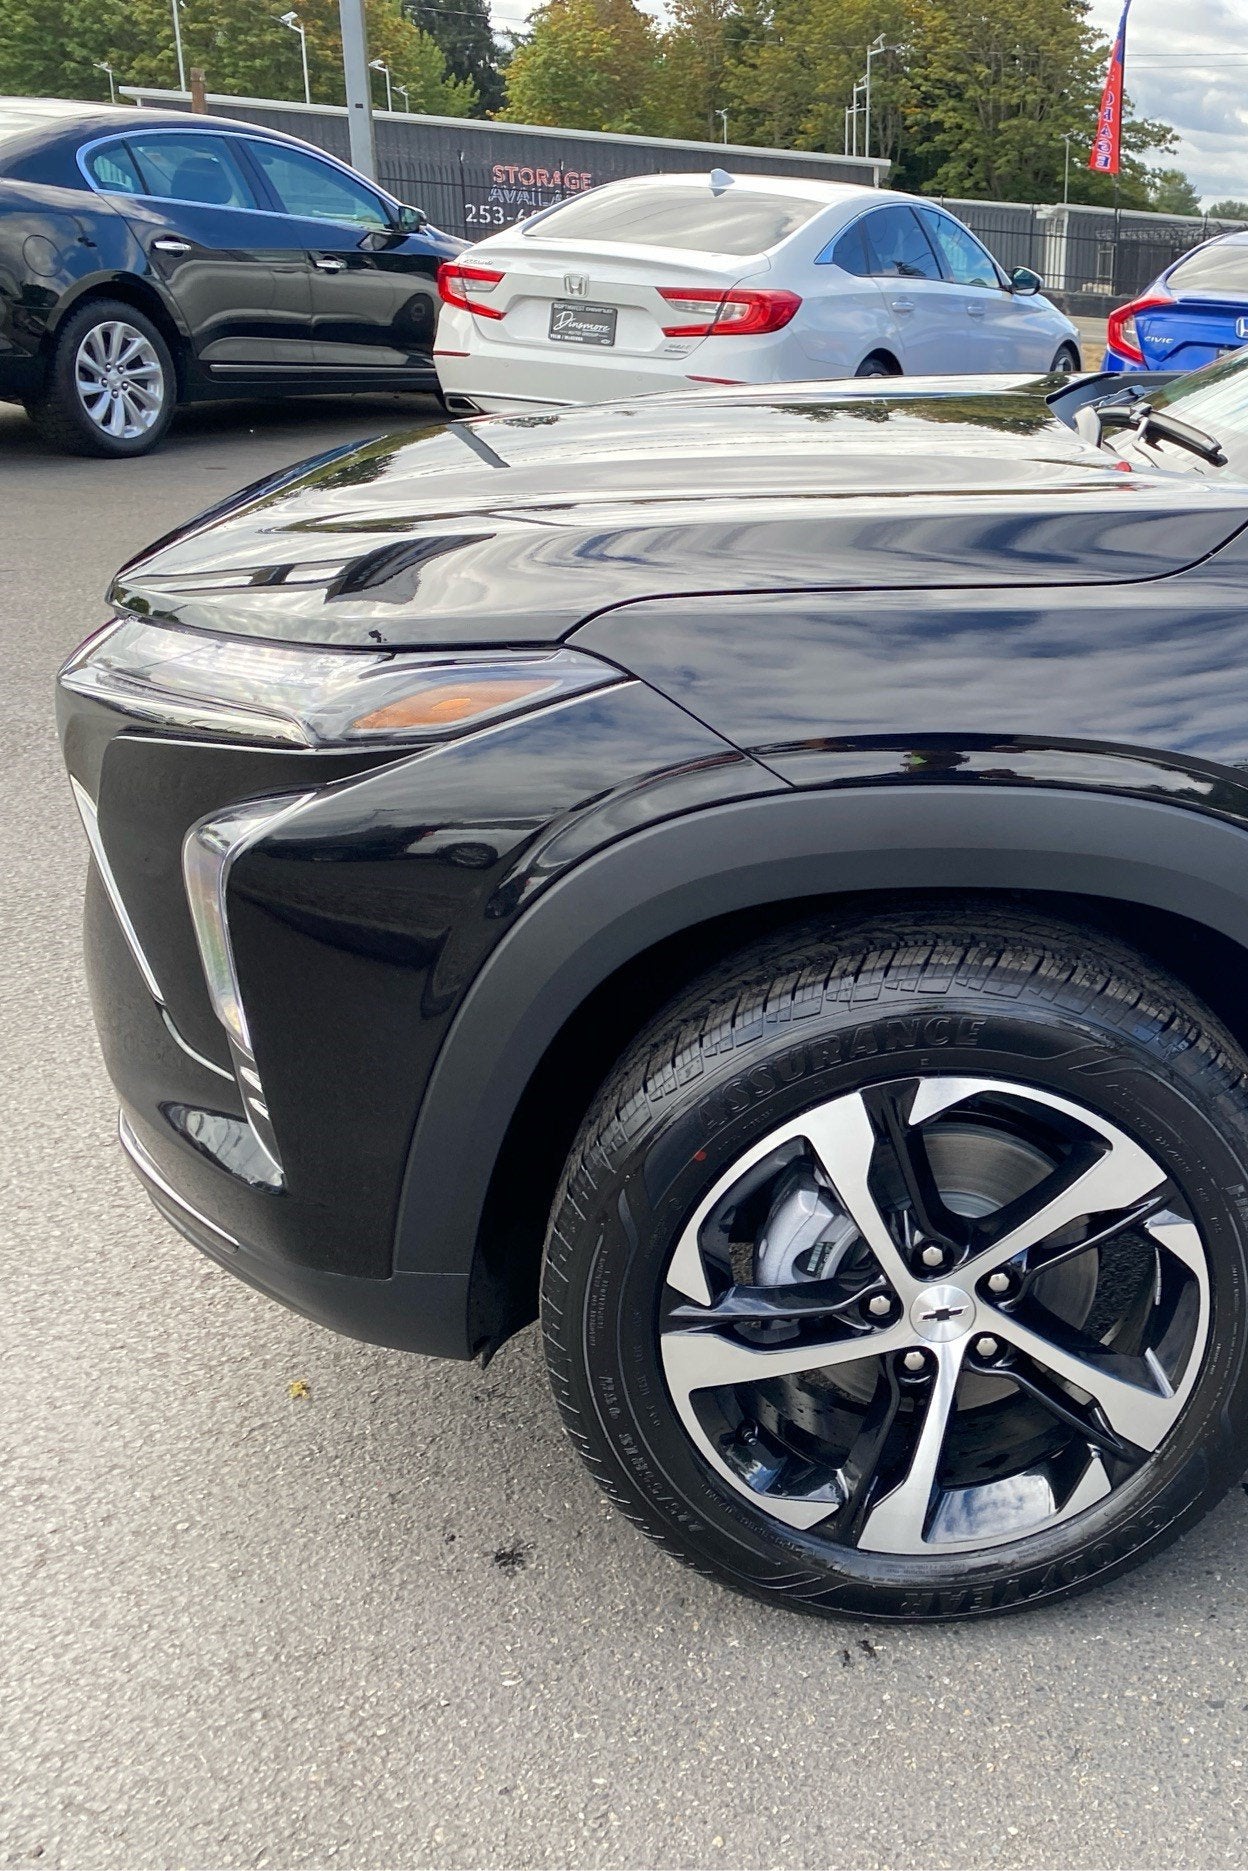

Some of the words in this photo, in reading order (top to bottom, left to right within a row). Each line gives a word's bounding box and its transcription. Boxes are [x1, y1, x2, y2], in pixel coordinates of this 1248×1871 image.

[492, 164, 592, 190] STORAGE
[553, 311, 611, 332] Dinsmore
[1144, 335, 1174, 344] CIVIC
[699, 1015, 986, 1128] ASSURANCE
[899, 1504, 1167, 1616] GOODYEAR
